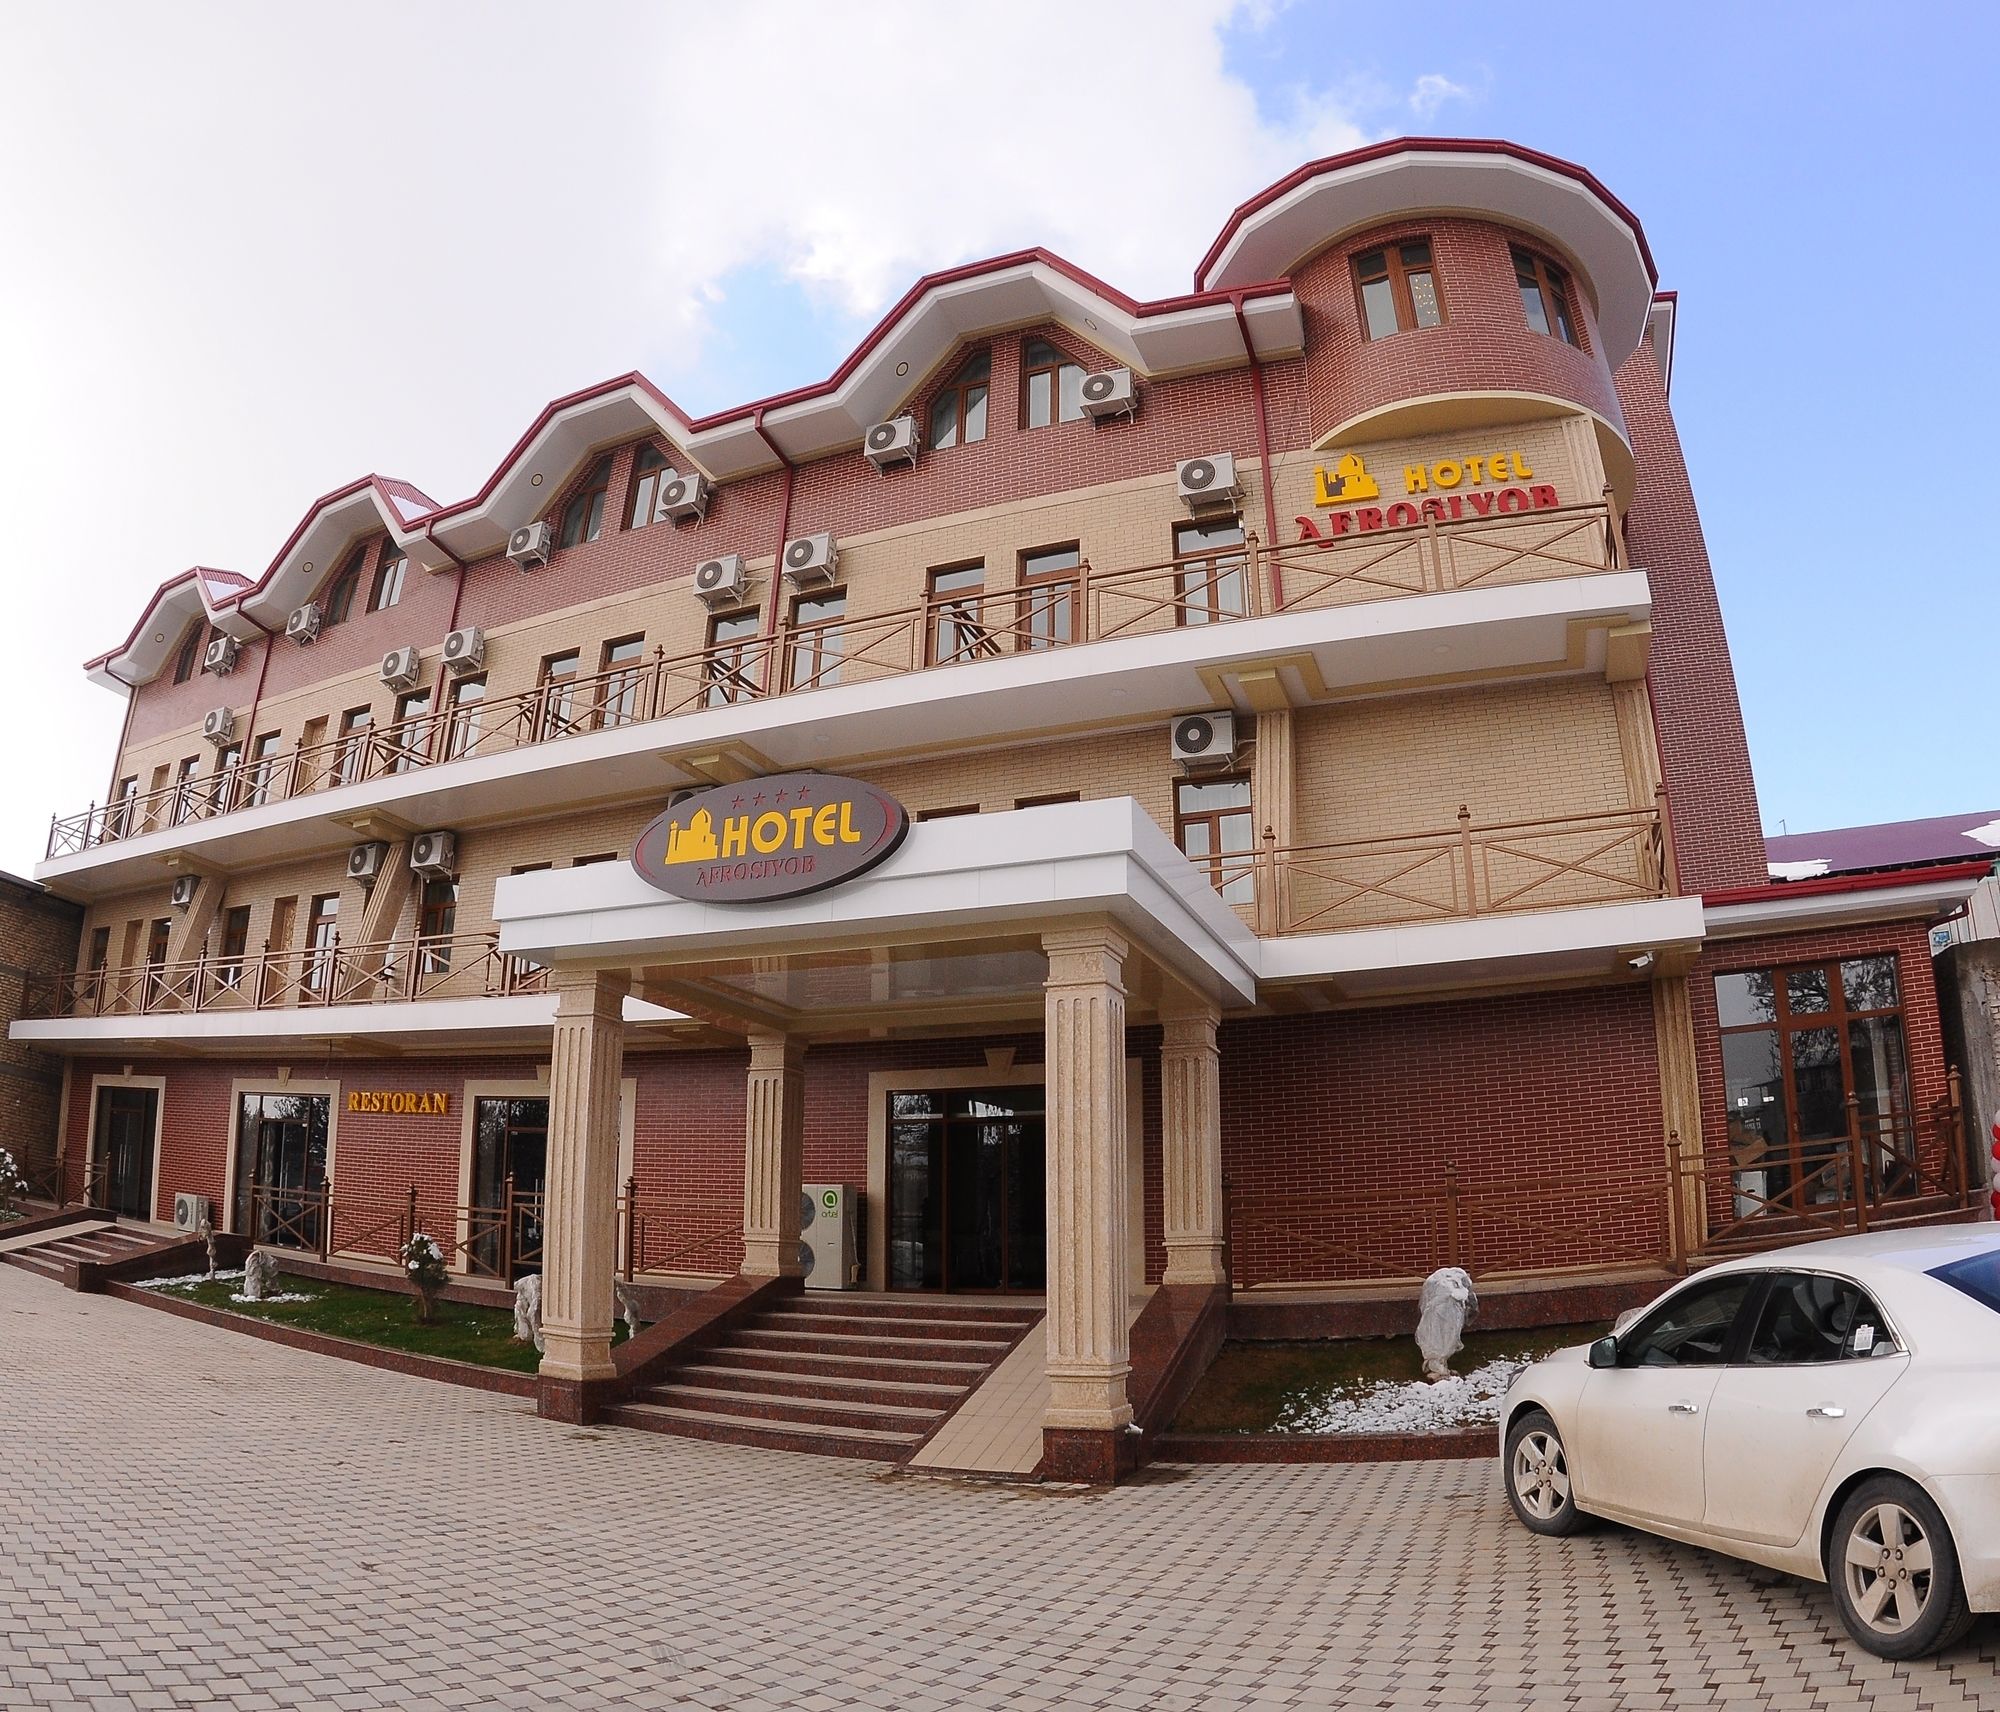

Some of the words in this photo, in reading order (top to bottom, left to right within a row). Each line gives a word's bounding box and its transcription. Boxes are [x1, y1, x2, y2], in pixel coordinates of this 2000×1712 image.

[1403, 451, 1533, 494] HOTEL
[721, 801, 862, 858] HOTEL
[696, 855, 816, 888] AFROSIYOB
[347, 1091, 447, 1115] RESTORAN
